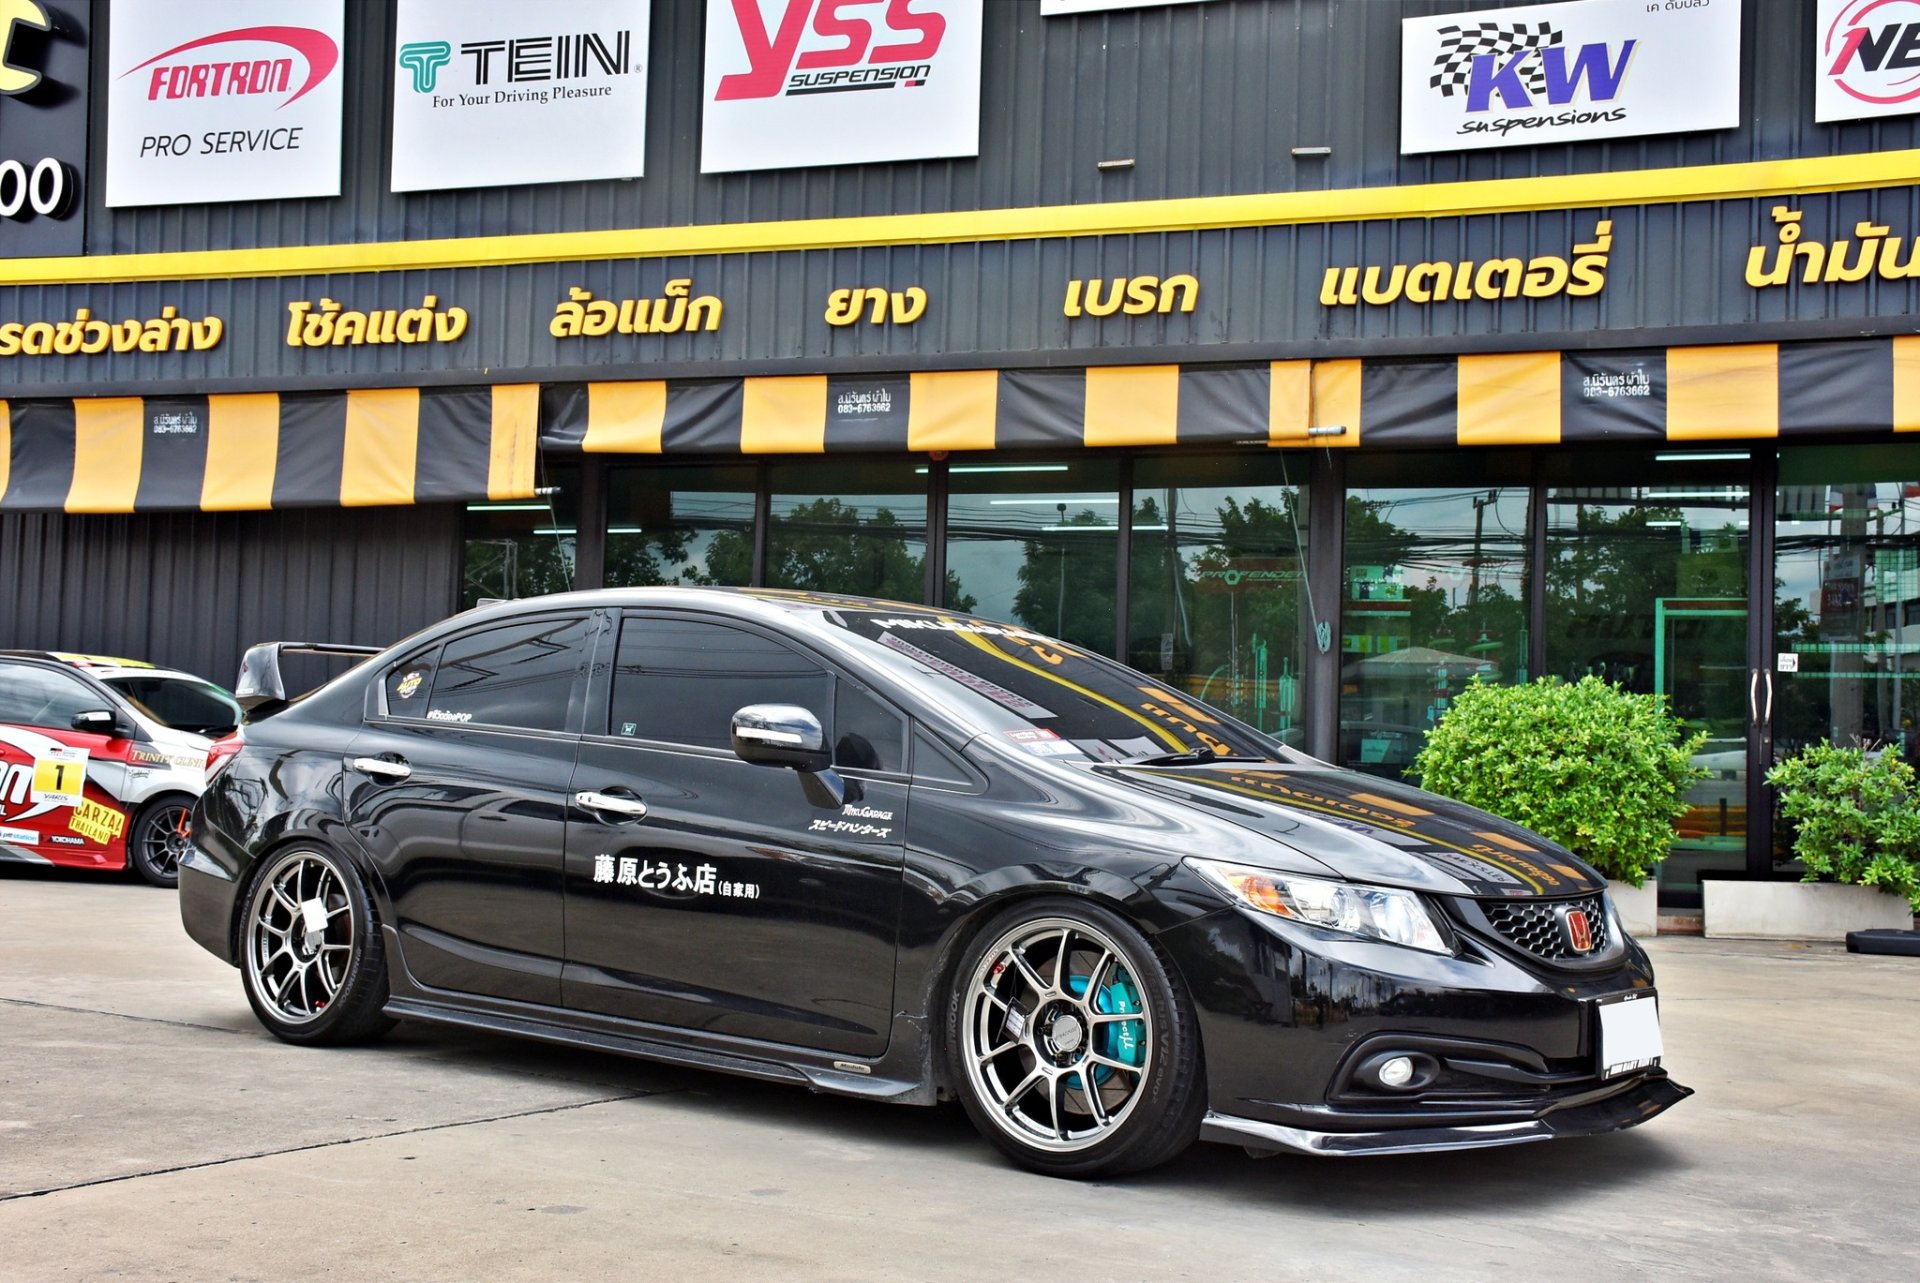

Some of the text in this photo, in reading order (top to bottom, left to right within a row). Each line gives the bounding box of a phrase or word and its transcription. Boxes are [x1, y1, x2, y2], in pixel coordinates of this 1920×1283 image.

[461, 30, 630, 85] TEIN
[788, 64, 931, 88] SUSPENSION
[1465, 39, 1641, 113] KW
[148, 59, 293, 101] FORTRON
[433, 86, 612, 108] For Your Driving Pleasure
[139, 127, 303, 158] PRO SERVICE
[1456, 107, 1627, 137] suspensions
[1319, 219, 1613, 306] แบตเตอรี่
[549, 278, 724, 338] ล้อแม็ก
[824, 285, 928, 326] ยาง
[1063, 273, 1199, 318] เบรก
[287, 295, 468, 347] โช้คแต่ง
[55, 764, 64, 790] 1
